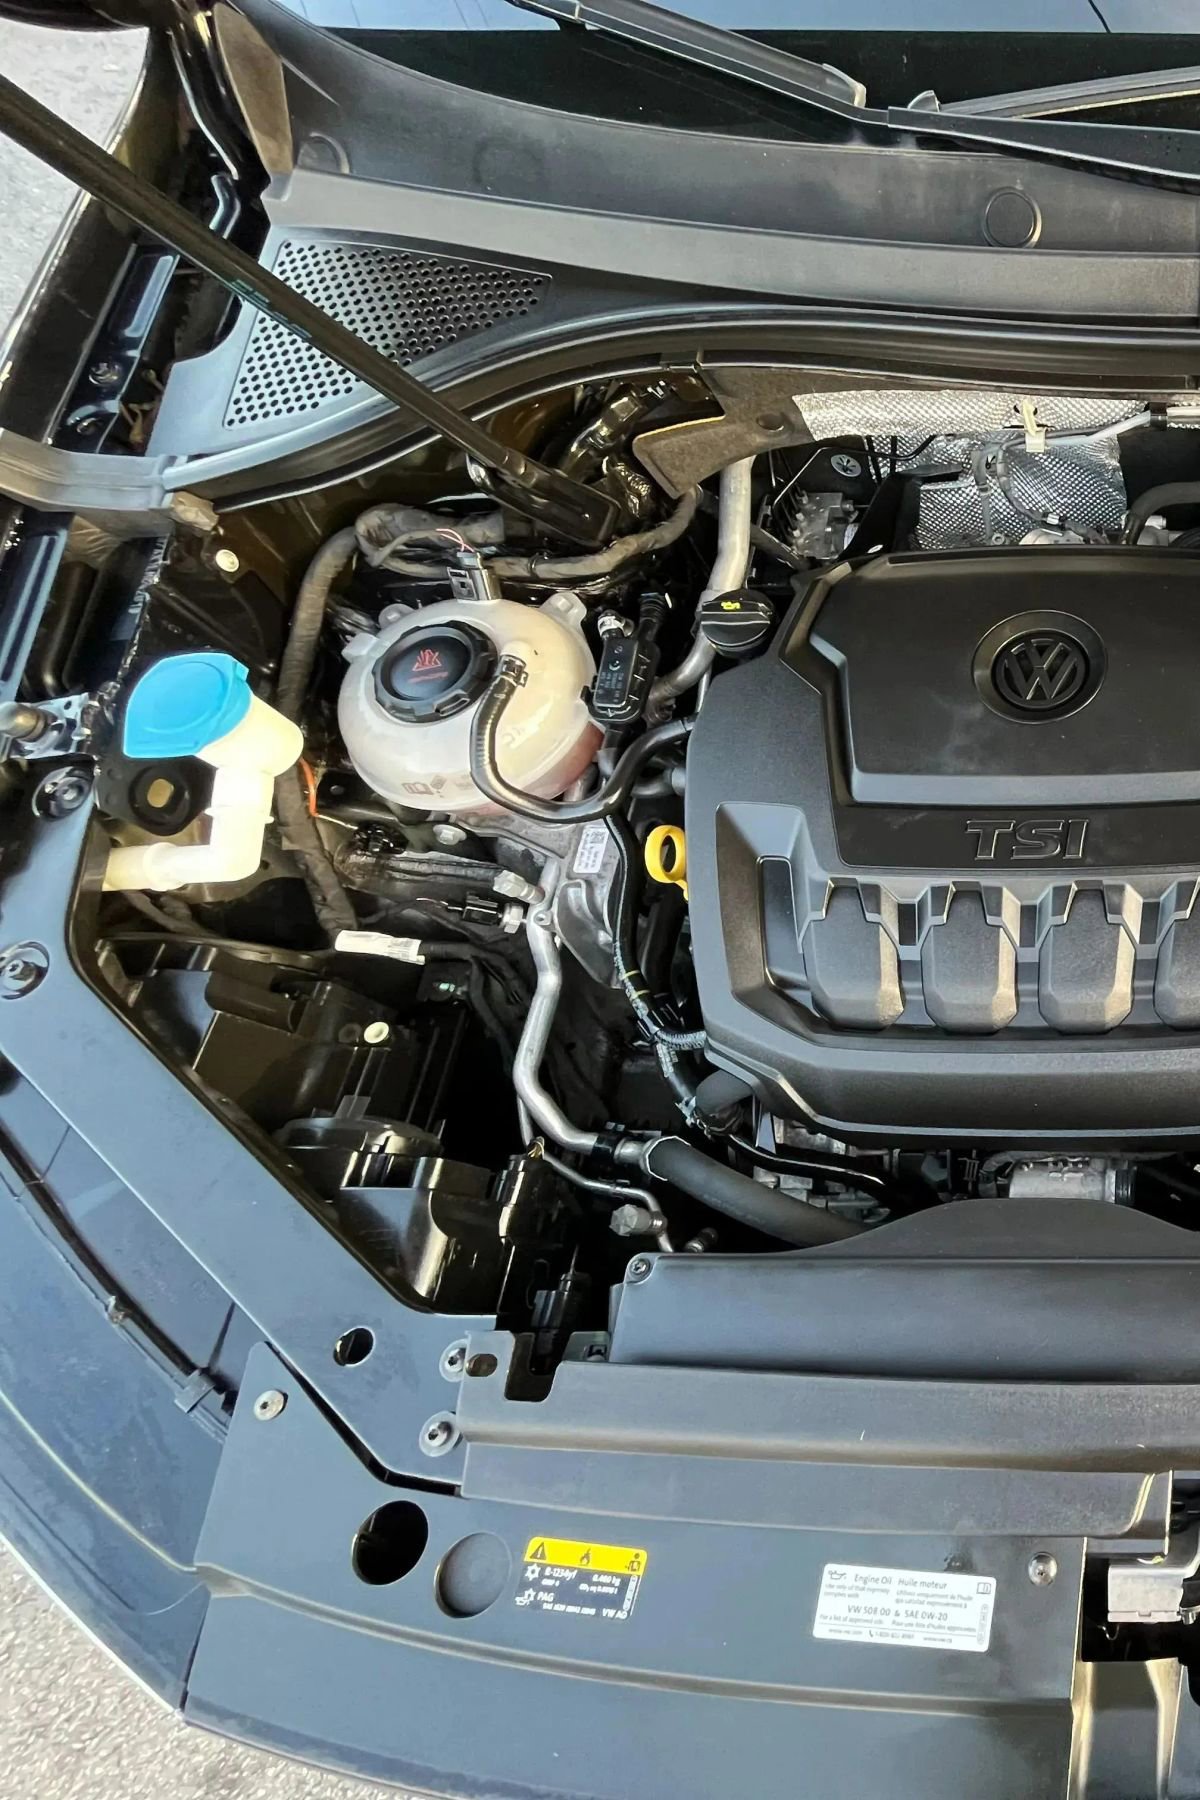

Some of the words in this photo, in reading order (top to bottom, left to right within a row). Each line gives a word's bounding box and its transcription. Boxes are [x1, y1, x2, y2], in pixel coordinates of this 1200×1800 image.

[965, 818, 1089, 861] TSI
[854, 1573, 880, 1586] Engine
[880, 1575, 892, 1585] Oil
[897, 1577, 918, 1588] Huile
[919, 1578, 947, 1590] moteur
[536, 1591, 555, 1602] PAG
[602, 1608, 615, 1619] VW
[847, 1604, 863, 1613] VW
[863, 1606, 879, 1616] 508
[879, 1607, 891, 1617] 00
[894, 1609, 901, 1617] &
[904, 1609, 920, 1619] SAE
[920, 1611, 948, 1621] 0W-20
